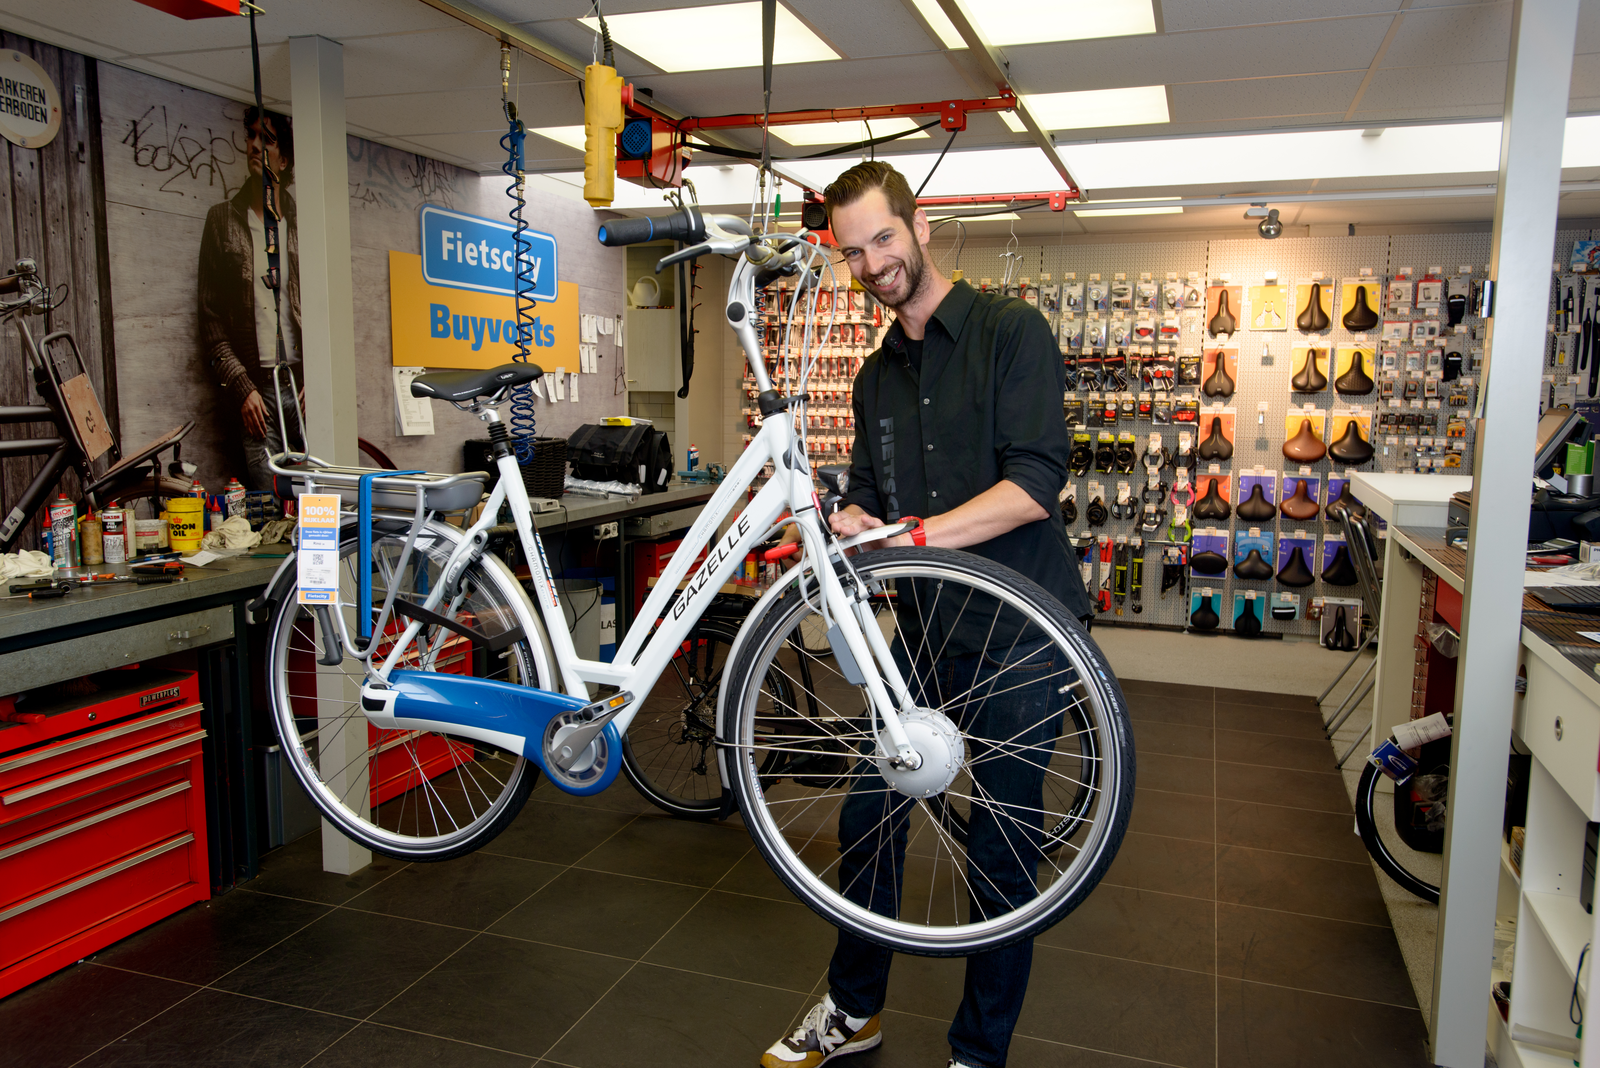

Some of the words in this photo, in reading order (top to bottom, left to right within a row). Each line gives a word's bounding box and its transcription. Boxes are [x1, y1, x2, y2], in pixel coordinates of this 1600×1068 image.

[429, 302, 556, 352] Buyvoets
[8, 516, 19, 526] 4
[304, 506, 335, 516] 100%
[672, 514, 751, 621] GAZELLE
[1072, 633, 1099, 668] SCHWALBE
[1104, 682, 1119, 713] CITIZEN
